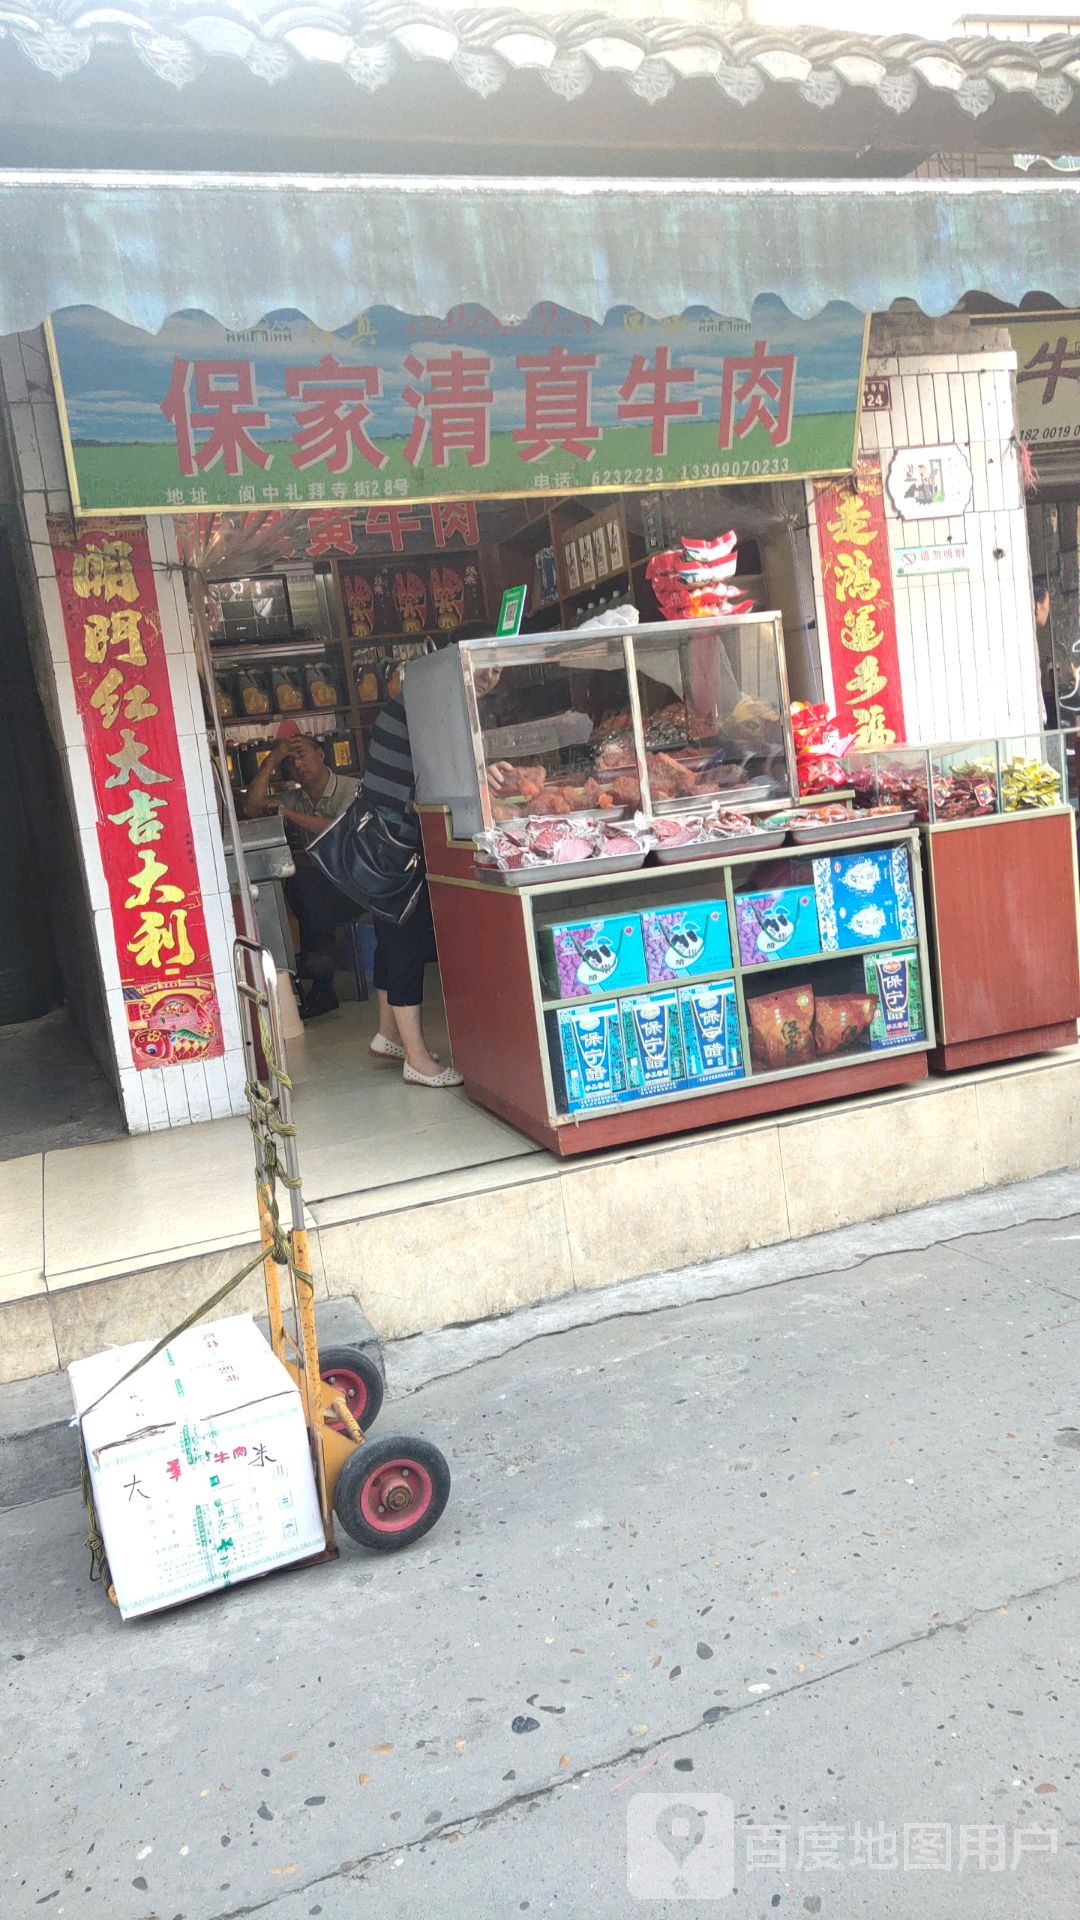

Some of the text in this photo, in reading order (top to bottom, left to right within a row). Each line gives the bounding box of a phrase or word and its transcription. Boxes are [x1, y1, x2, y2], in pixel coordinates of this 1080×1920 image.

[1016, 336, 1080, 405] 牛
[160, 341, 798, 478] 保家清真牛肉
[1020, 428, 1040, 441] 182
[1042, 426, 1070, 440] 0019
[591, 466, 664, 486] 6232223
[680, 458, 790, 481] 13309070233
[920, 547, 965, 561] 请勿吸烟
[883, 975, 906, 1021] 保宁醋
[580, 1032, 608, 1082] 保宁醋
[641, 1021, 667, 1070] 保宁醋
[123, 1474, 151, 1501] 大
